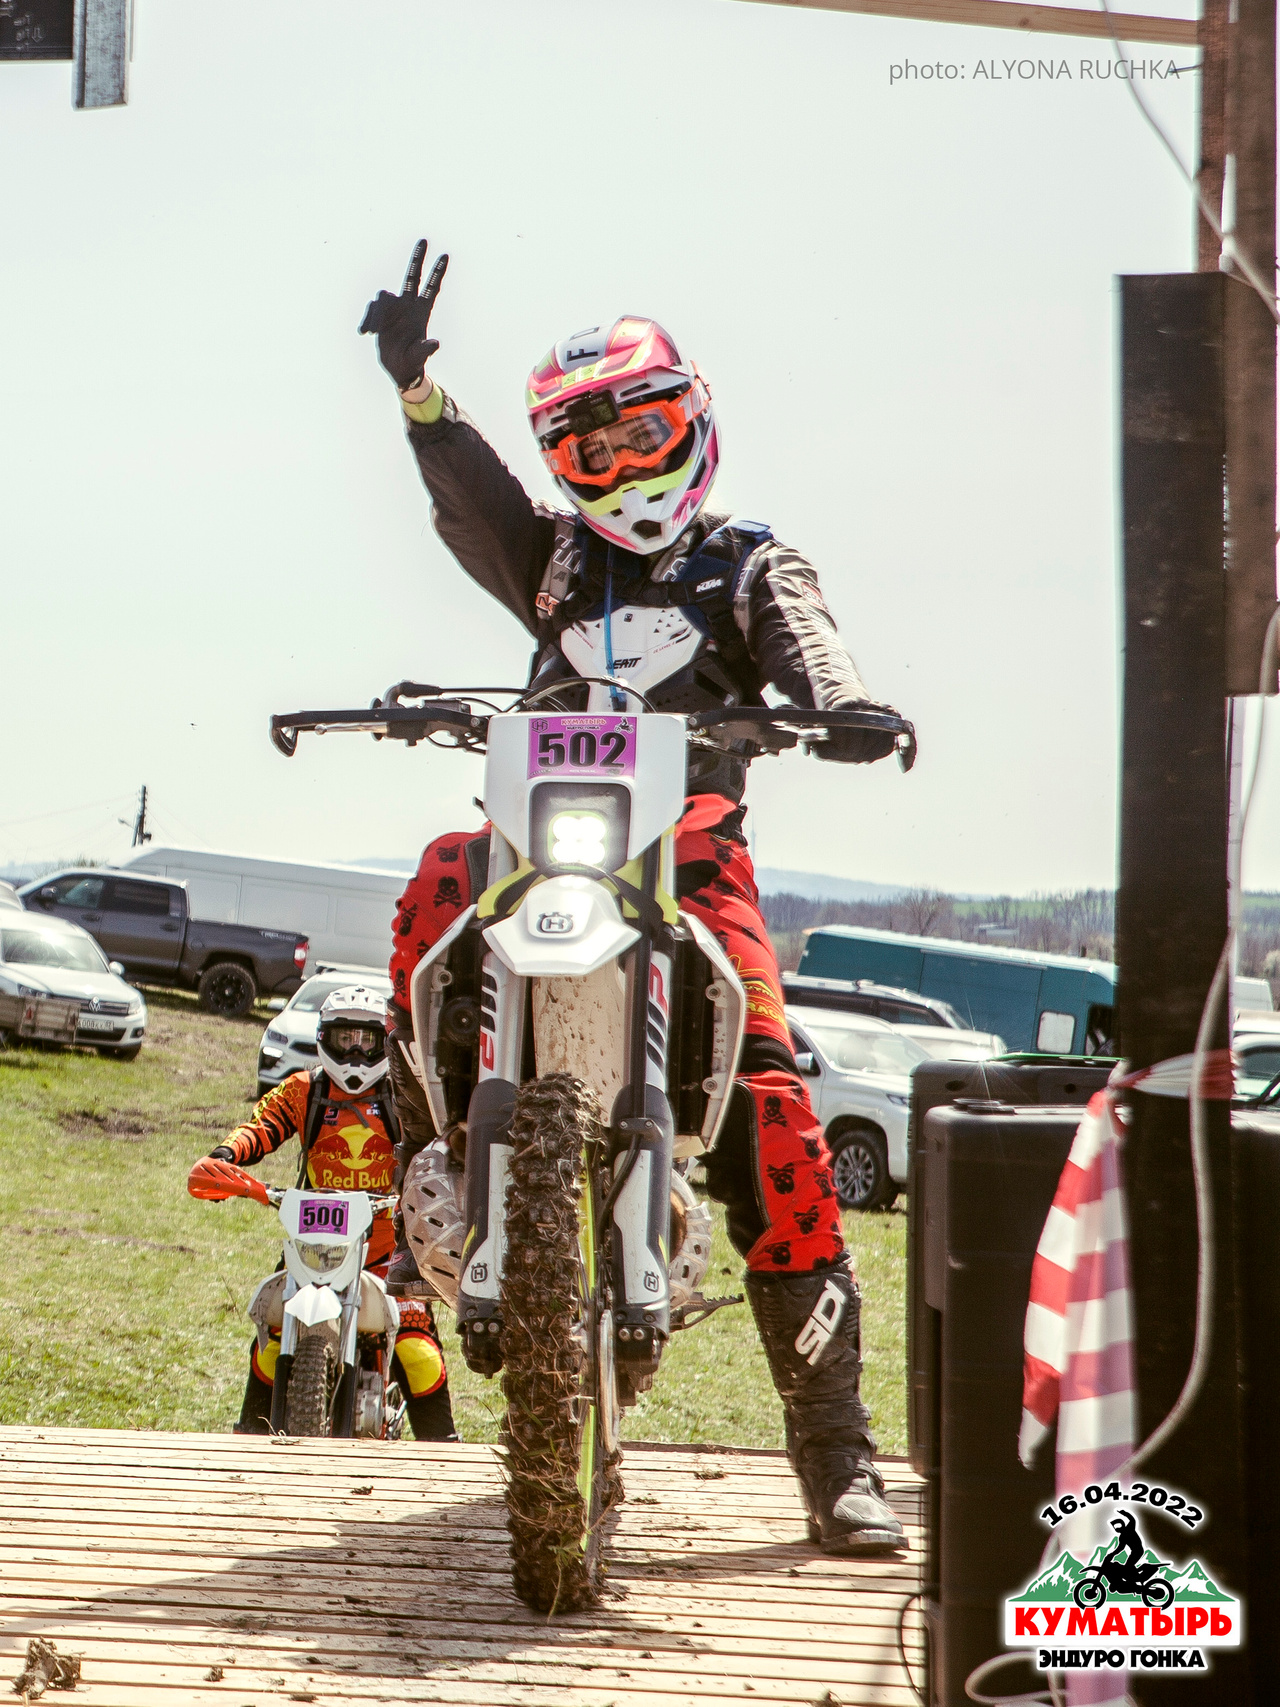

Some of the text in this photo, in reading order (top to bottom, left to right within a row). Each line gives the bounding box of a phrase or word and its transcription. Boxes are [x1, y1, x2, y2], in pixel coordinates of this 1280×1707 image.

[538, 731, 627, 768] 502
[322, 1168, 390, 1189] Red Bull
[302, 1206, 345, 1227] 500
